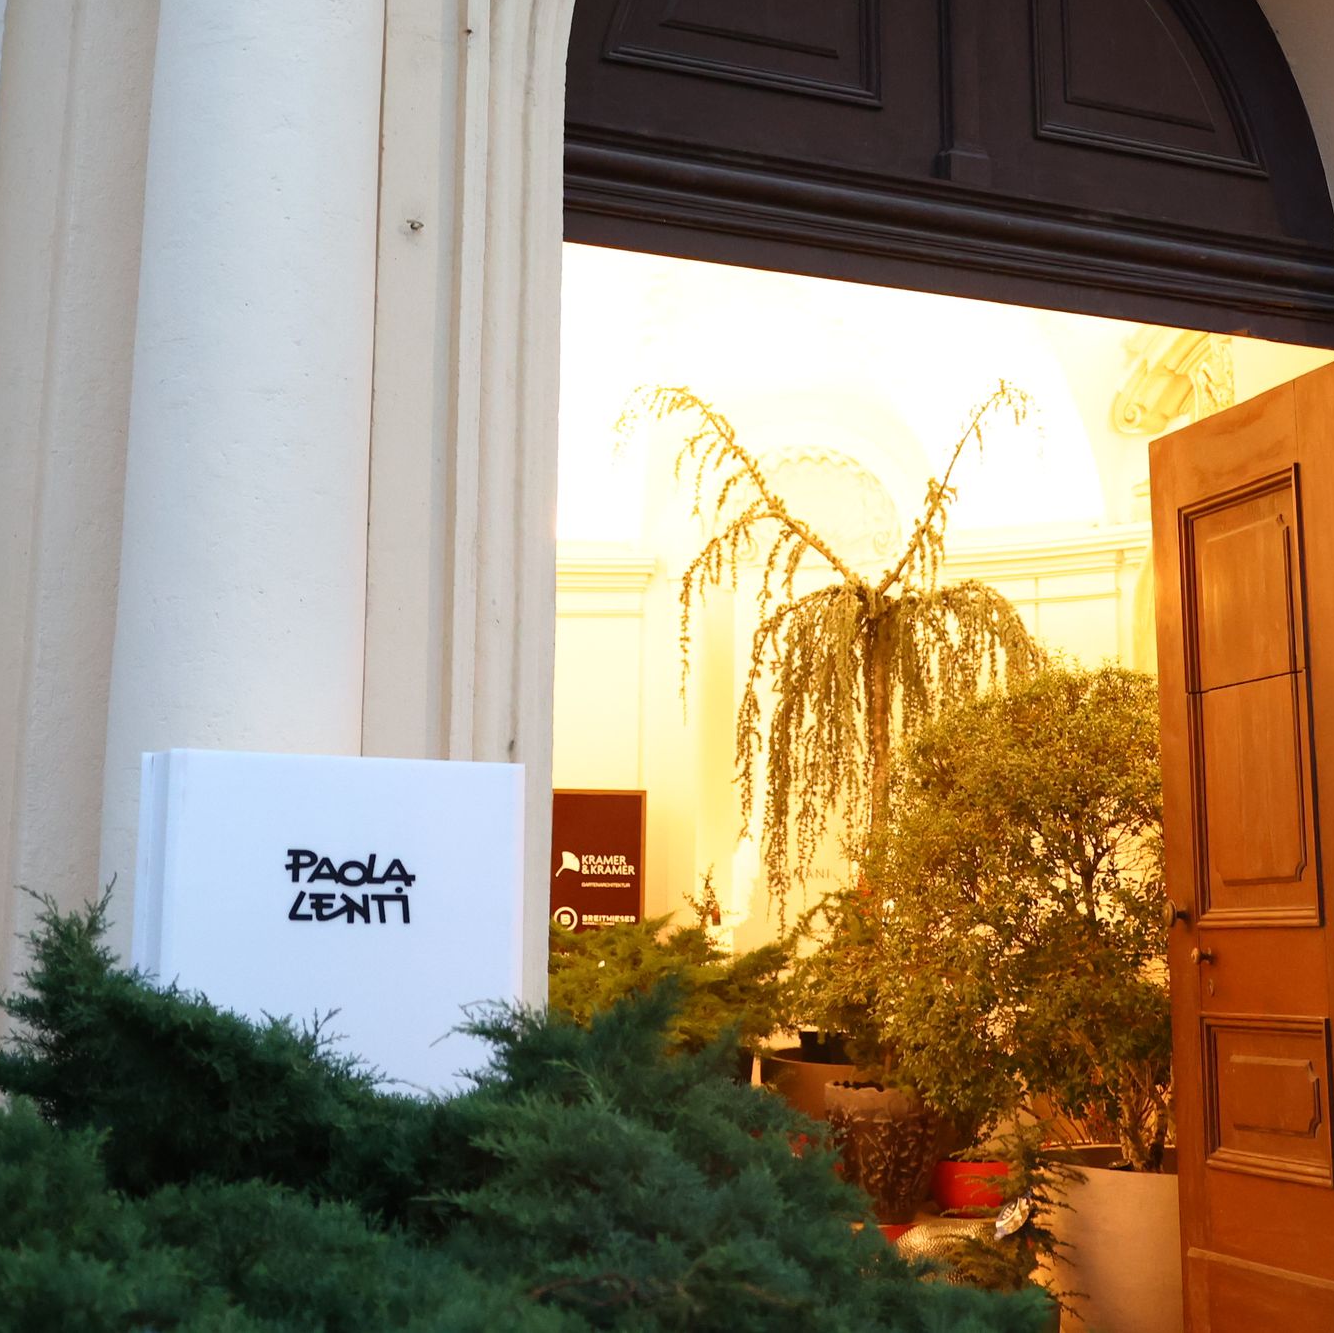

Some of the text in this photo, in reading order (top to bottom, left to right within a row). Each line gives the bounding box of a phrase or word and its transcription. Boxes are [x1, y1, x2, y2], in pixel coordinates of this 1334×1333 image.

[284, 849, 416, 887] PAOLA
[581, 854, 627, 866] KRAMER
[288, 886, 410, 924] LENTI
